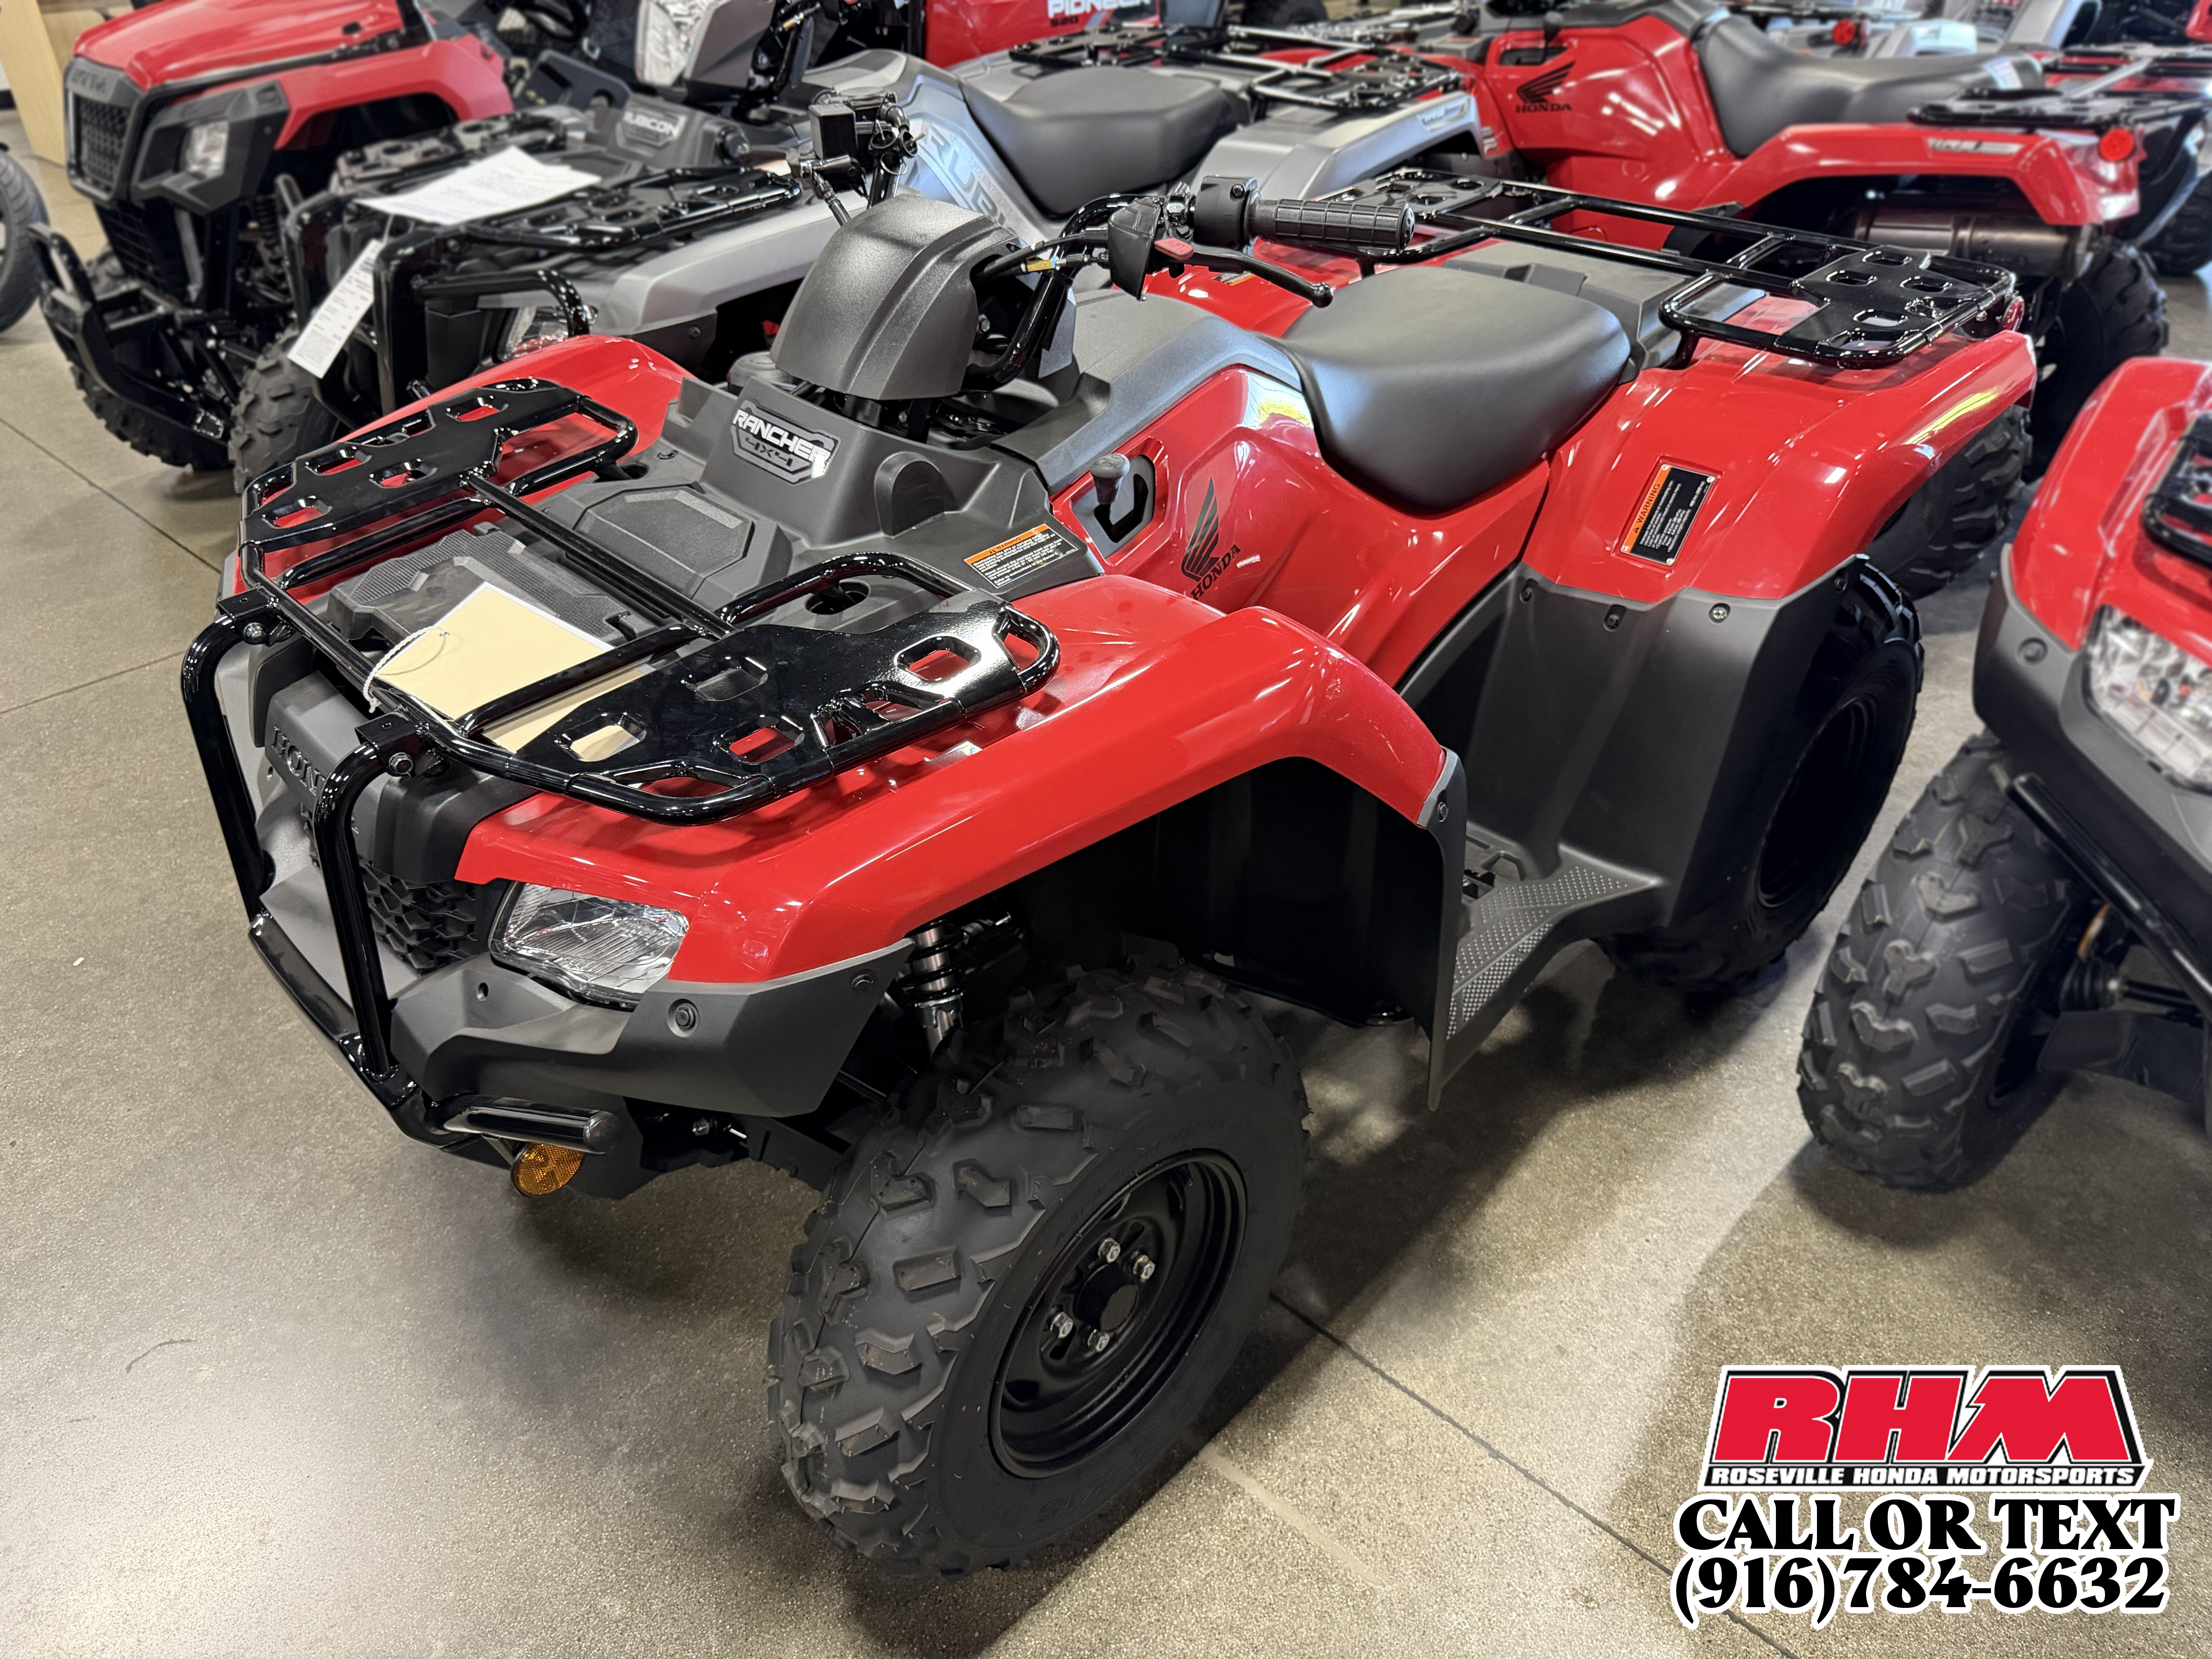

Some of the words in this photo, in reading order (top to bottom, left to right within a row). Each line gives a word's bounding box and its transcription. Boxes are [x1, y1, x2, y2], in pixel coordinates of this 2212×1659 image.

[1048, 0, 1151, 18] PIONE
[1516, 102, 1573, 113] HONDA
[923, 123, 1008, 226] RUBI
[732, 409, 831, 463] RANCHER
[1635, 484, 1660, 524] WARNING
[996, 537, 1022, 550] WARNING
[1191, 544, 1241, 600] HONDA
[271, 725, 326, 797] HON
